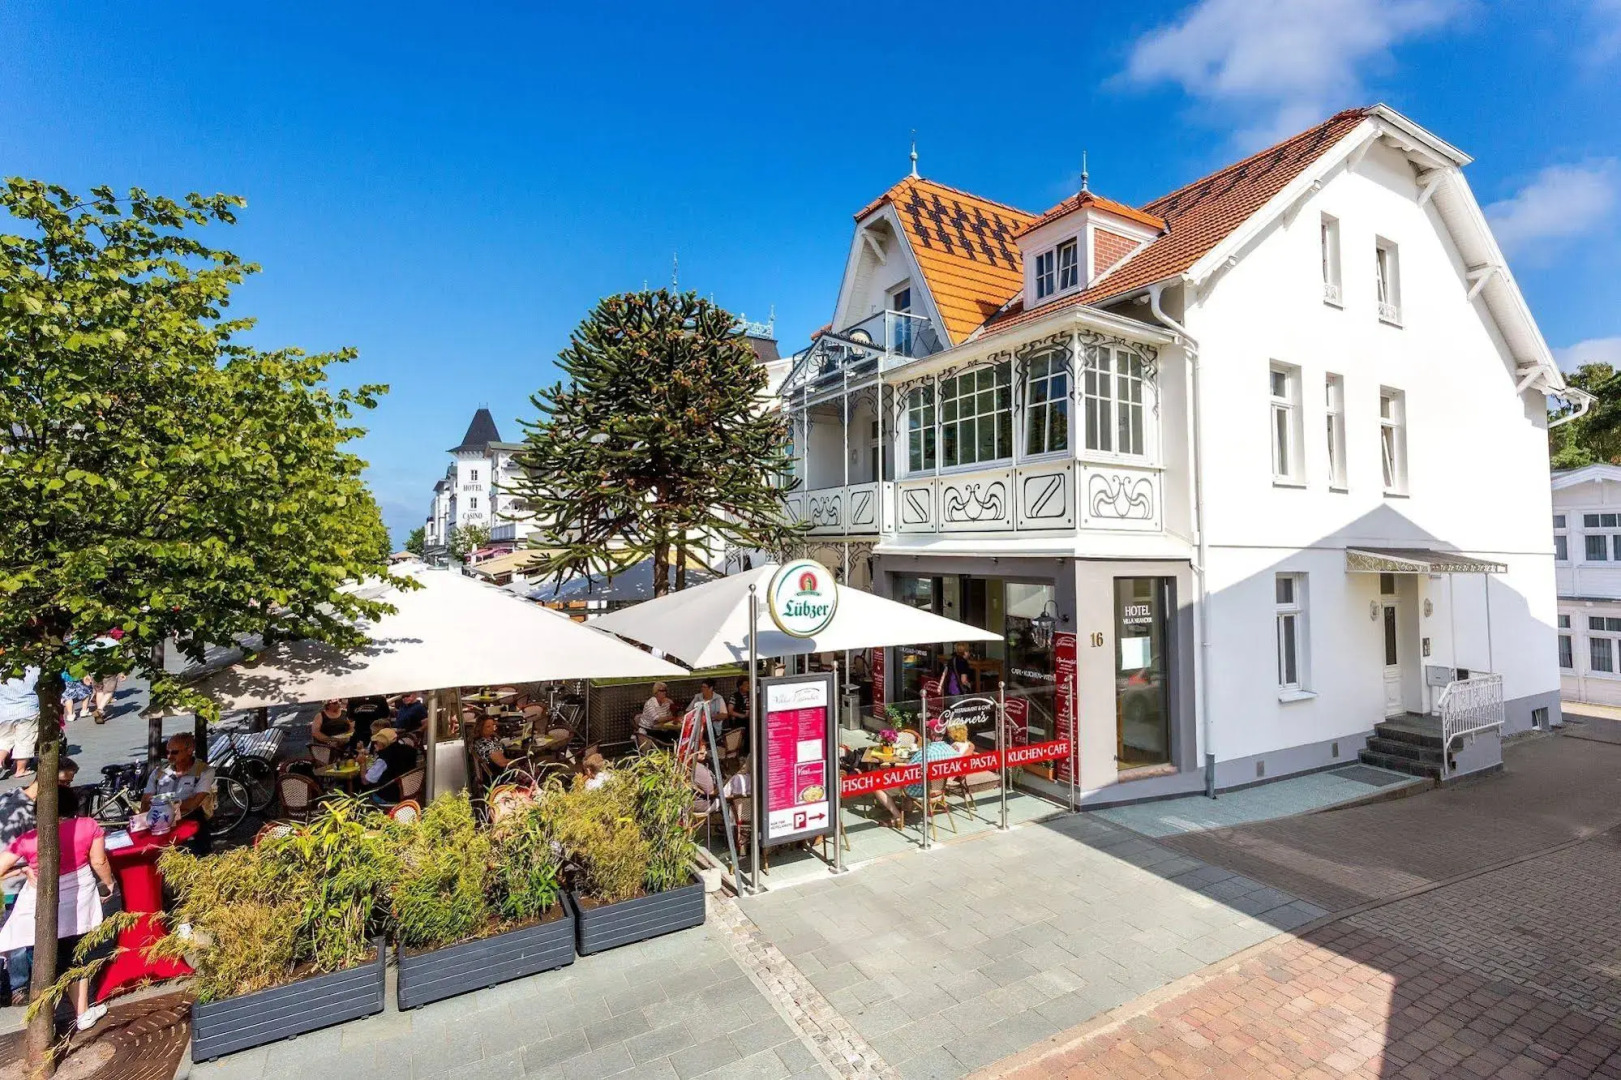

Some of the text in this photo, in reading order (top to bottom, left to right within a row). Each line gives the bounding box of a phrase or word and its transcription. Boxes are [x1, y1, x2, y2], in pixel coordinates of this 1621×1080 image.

[782, 599, 829, 619] Lübzer
[1125, 605, 1151, 616] HOTEL
[1090, 632, 1104, 647] 16
[934, 710, 989, 733] Glasner's
[842, 775, 873, 793] FISCH
[883, 767, 921, 785] SALATE
[931, 760, 962, 776] STEAK
[969, 755, 998, 769] PASTA
[1008, 747, 1044, 763] KUCHEN
[1047, 743, 1069, 756] CAFE
